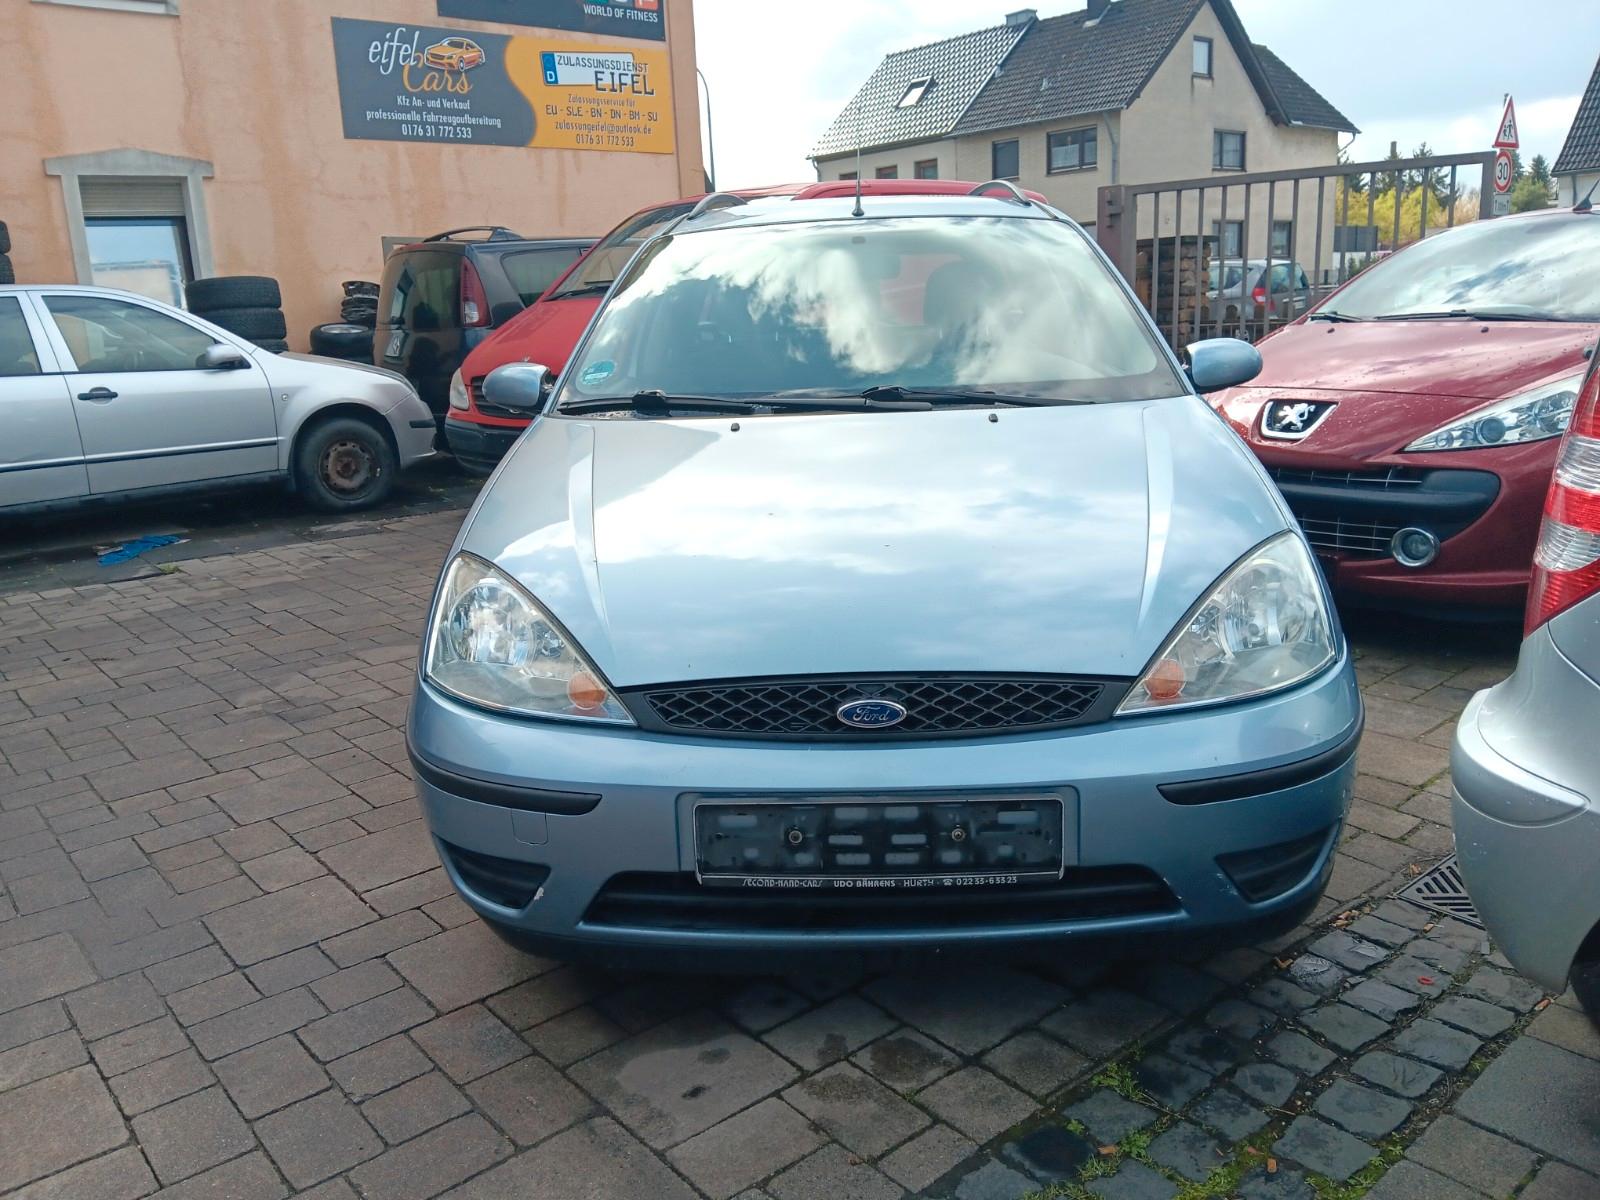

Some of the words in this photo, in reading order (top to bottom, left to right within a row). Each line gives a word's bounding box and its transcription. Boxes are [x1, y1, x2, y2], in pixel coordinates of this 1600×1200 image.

[583, 4, 612, 17] WORLD
[614, 8, 625, 18] OF
[626, 9, 658, 23] FITNESS
[368, 27, 420, 75] eifel
[556, 54, 648, 73] ZULASSUNGSDIENST
[402, 52, 473, 94] Cars
[546, 70, 555, 82] D
[594, 70, 655, 96] EIFEL
[397, 95, 410, 106] Kfz
[412, 97, 425, 107] An-
[427, 99, 441, 108] und
[442, 98, 471, 110] Verkauf
[366, 109, 421, 122] professionelle
[422, 111, 501, 129] Fahrzeugaufbereitung
[545, 104, 558, 116] EU
[566, 106, 583, 117] SLE
[591, 107, 602, 118] BN
[610, 109, 621, 119] DN
[647, 111, 658, 122] SU
[401, 123, 424, 137] 0176
[425, 125, 435, 137] 31
[439, 125, 454, 138] 772
[456, 126, 472, 139] 533
[576, 134, 594, 145] 0176
[596, 134, 604, 145] 31
[607, 135, 620, 146] 772
[621, 135, 634, 147] 533
[1497, 162, 1508, 180] 30
[852, 706, 891, 721] Ford
[742, 878, 823, 888] SECOND-HAND-CARS
[833, 879, 854, 888] UDO
